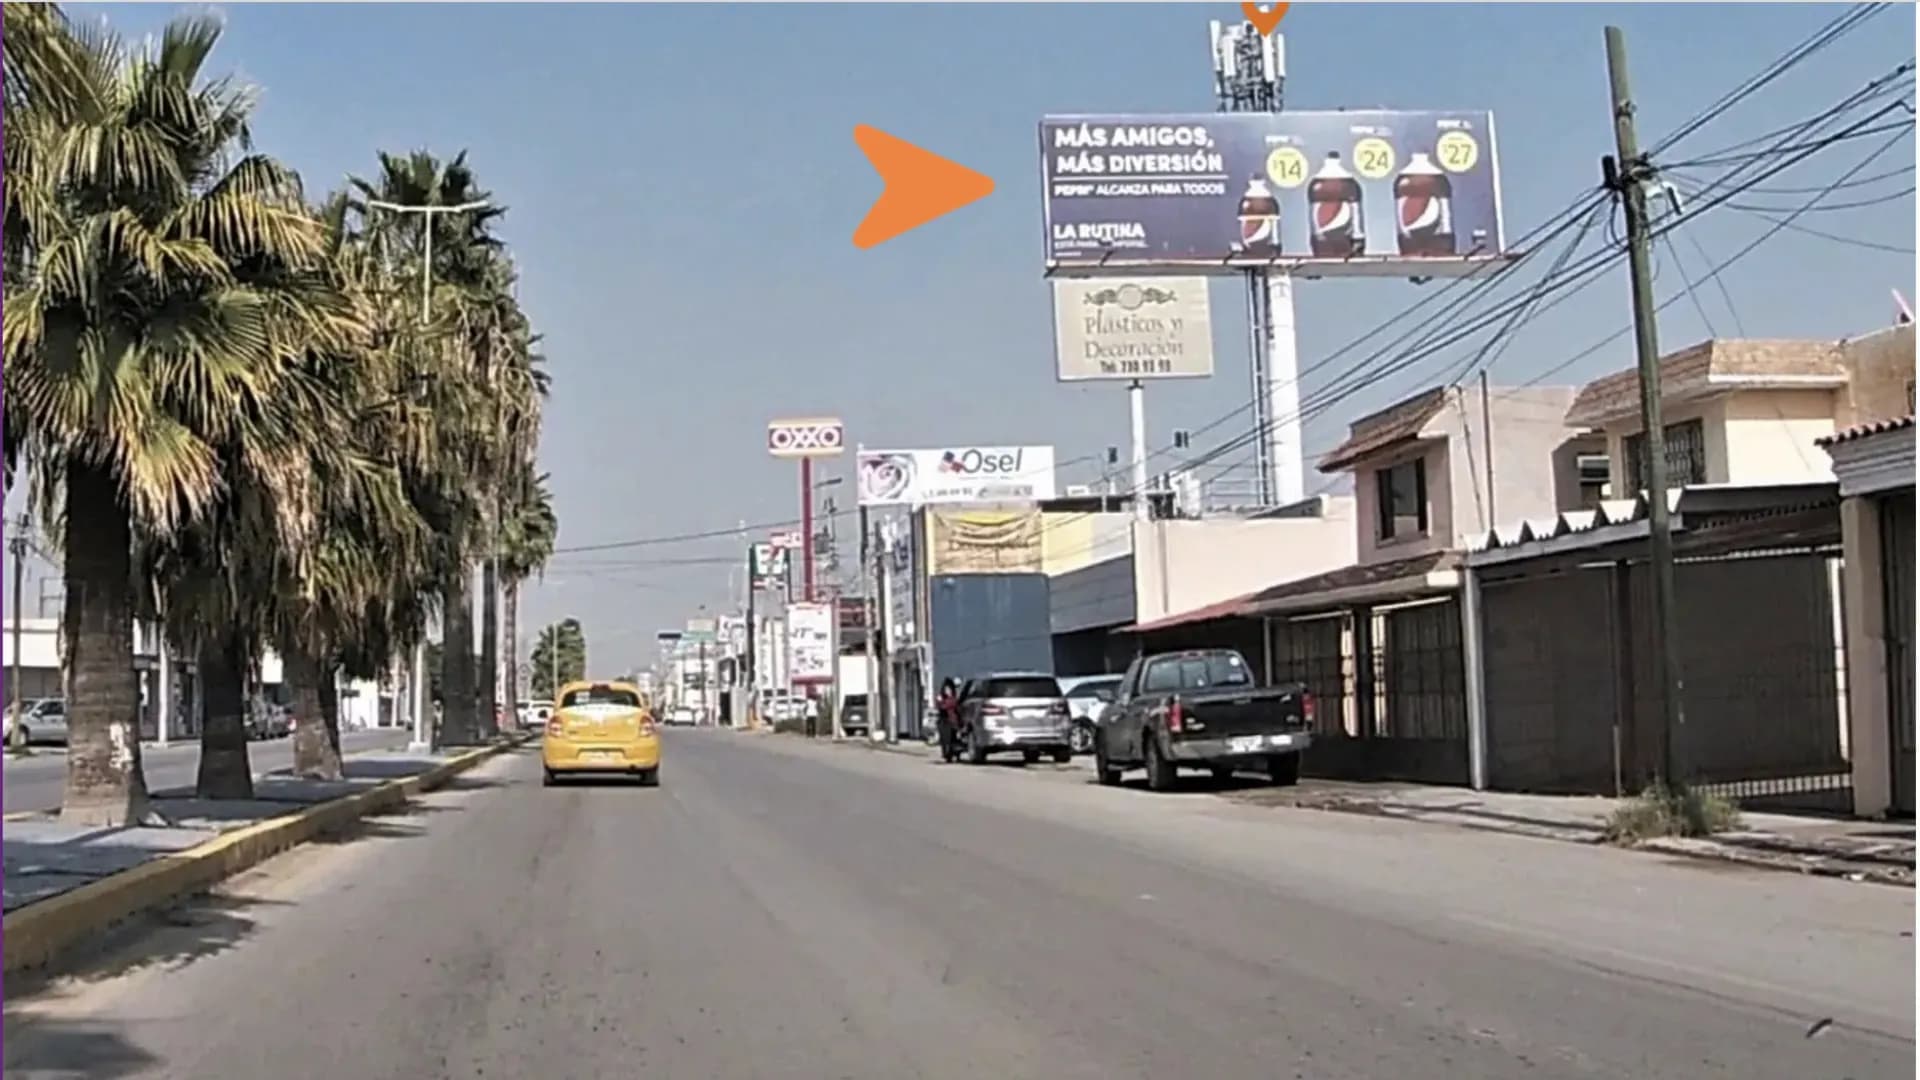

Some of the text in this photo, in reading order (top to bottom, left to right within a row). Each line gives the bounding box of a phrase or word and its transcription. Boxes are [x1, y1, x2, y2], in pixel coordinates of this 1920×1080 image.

[1055, 122, 1215, 148] MÁS AMIGOS,
[1057, 150, 1223, 173] MÁS DIVERSIÓN
[1096, 184, 1149, 195] ALCANZA
[1151, 183, 1182, 194] PARA
[1183, 183, 1226, 195] TODOS
[1054, 223, 1146, 240] LA RUTINA
[771, 427, 840, 449] OXXO
[961, 448, 1023, 474] Osel
